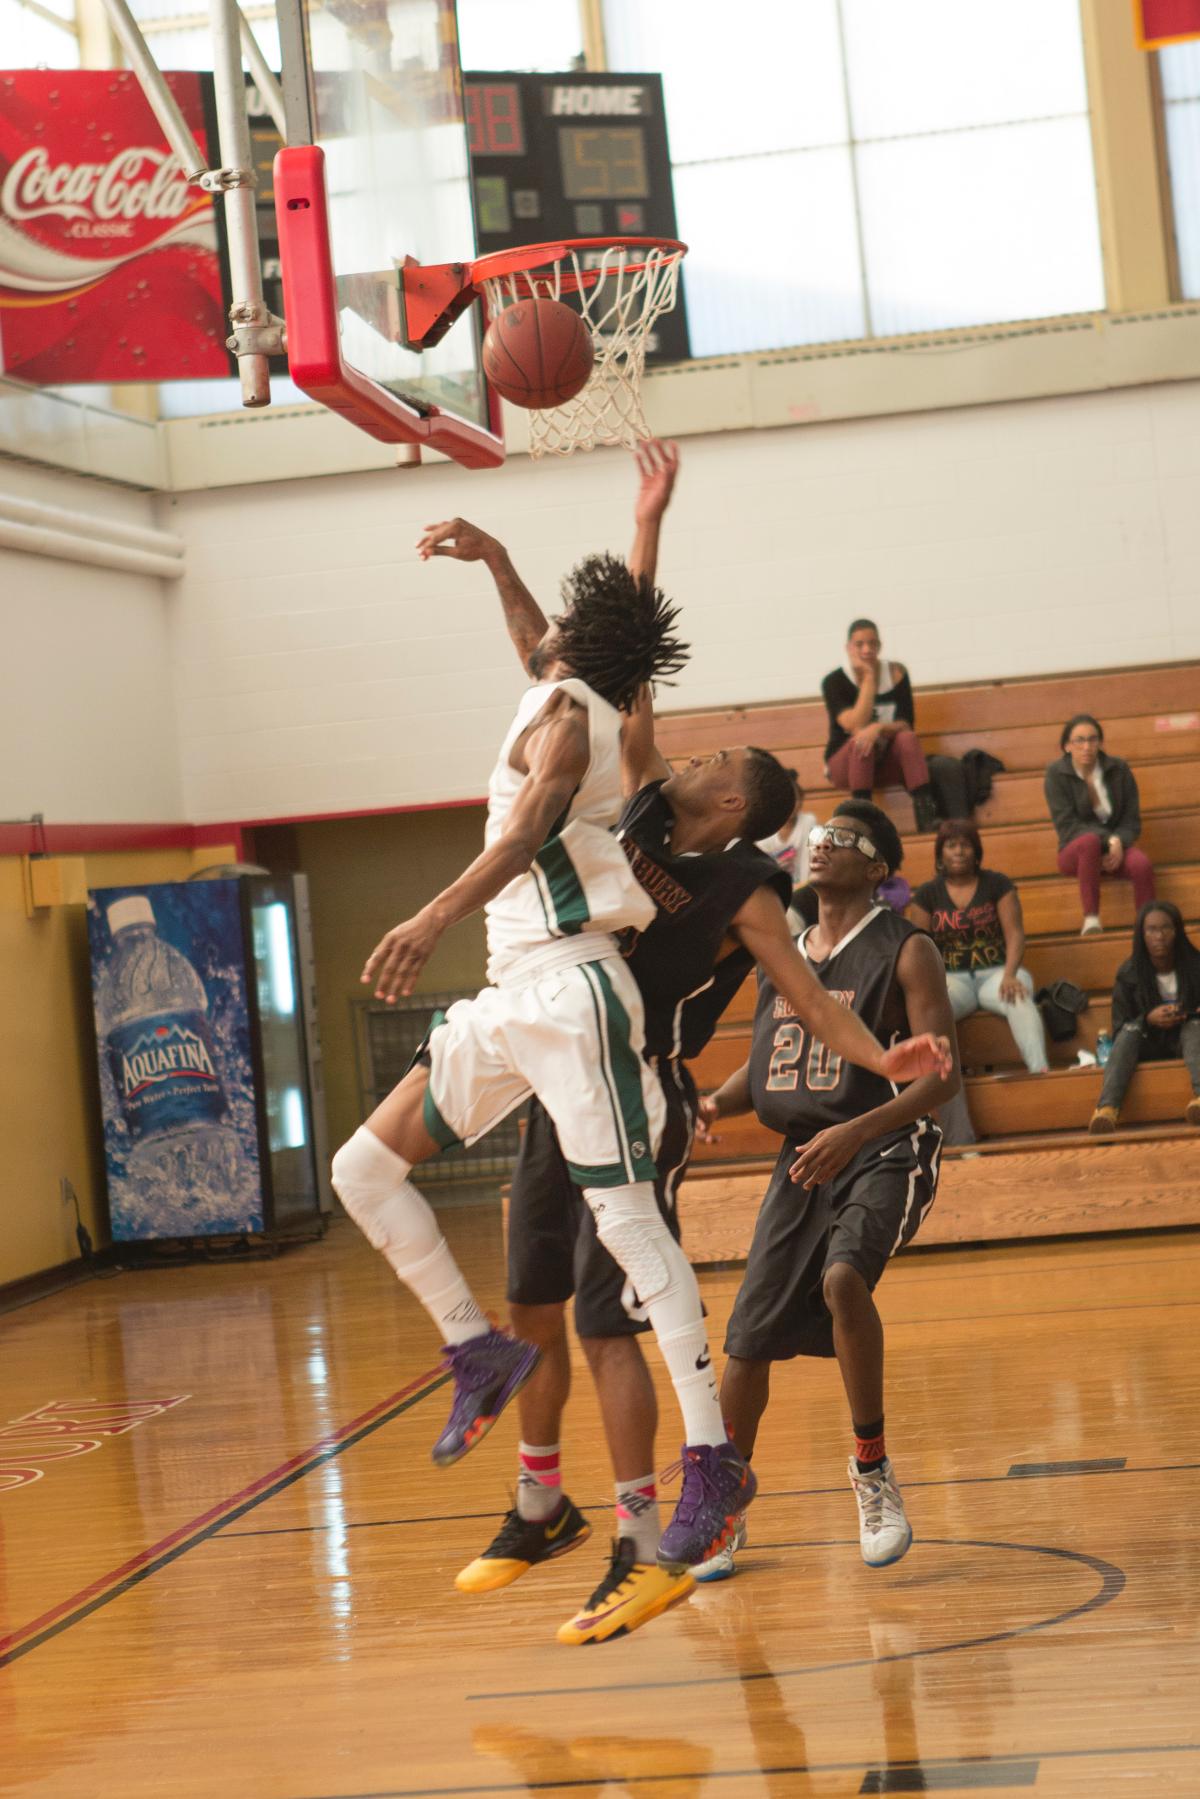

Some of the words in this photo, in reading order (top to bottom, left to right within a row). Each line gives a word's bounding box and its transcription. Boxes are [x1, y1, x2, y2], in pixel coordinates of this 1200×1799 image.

[552, 86, 643, 116] HOME
[2, 146, 194, 220] Coca-Cola
[122, 1039, 216, 1096] AQUAFINA
[766, 1023, 842, 1090] 20
